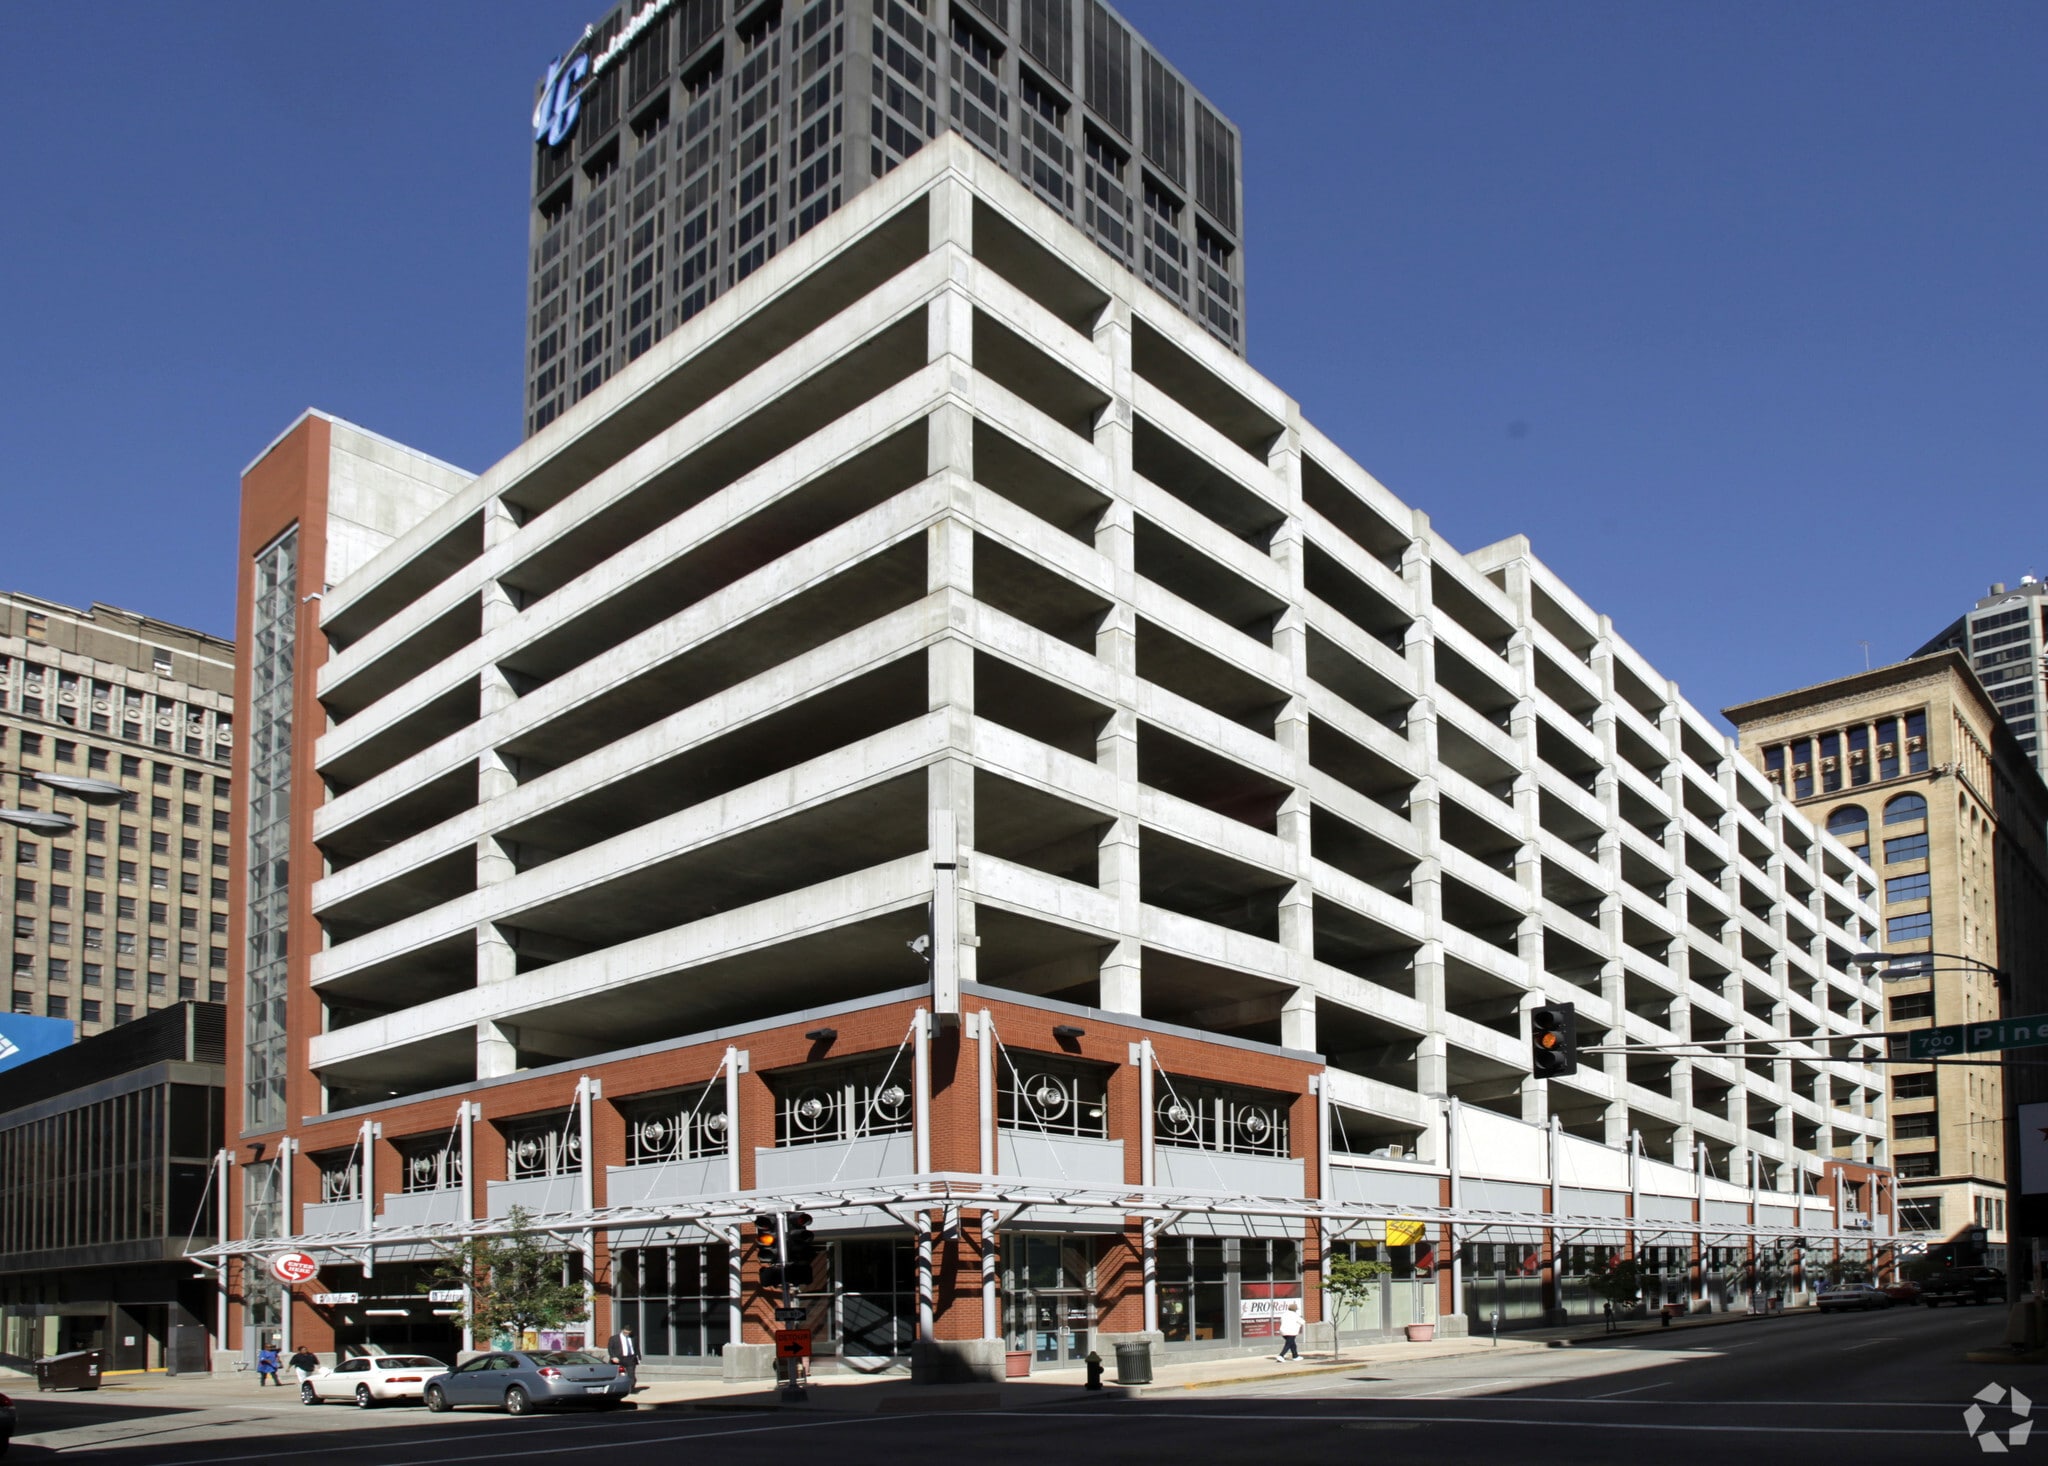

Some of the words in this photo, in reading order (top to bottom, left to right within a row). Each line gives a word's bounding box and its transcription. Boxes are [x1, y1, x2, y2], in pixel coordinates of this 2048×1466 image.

[1920, 1035, 1954, 1048] 700
[1973, 1024, 2048, 1046] Pine
[778, 1333, 808, 1341] DETOUR
